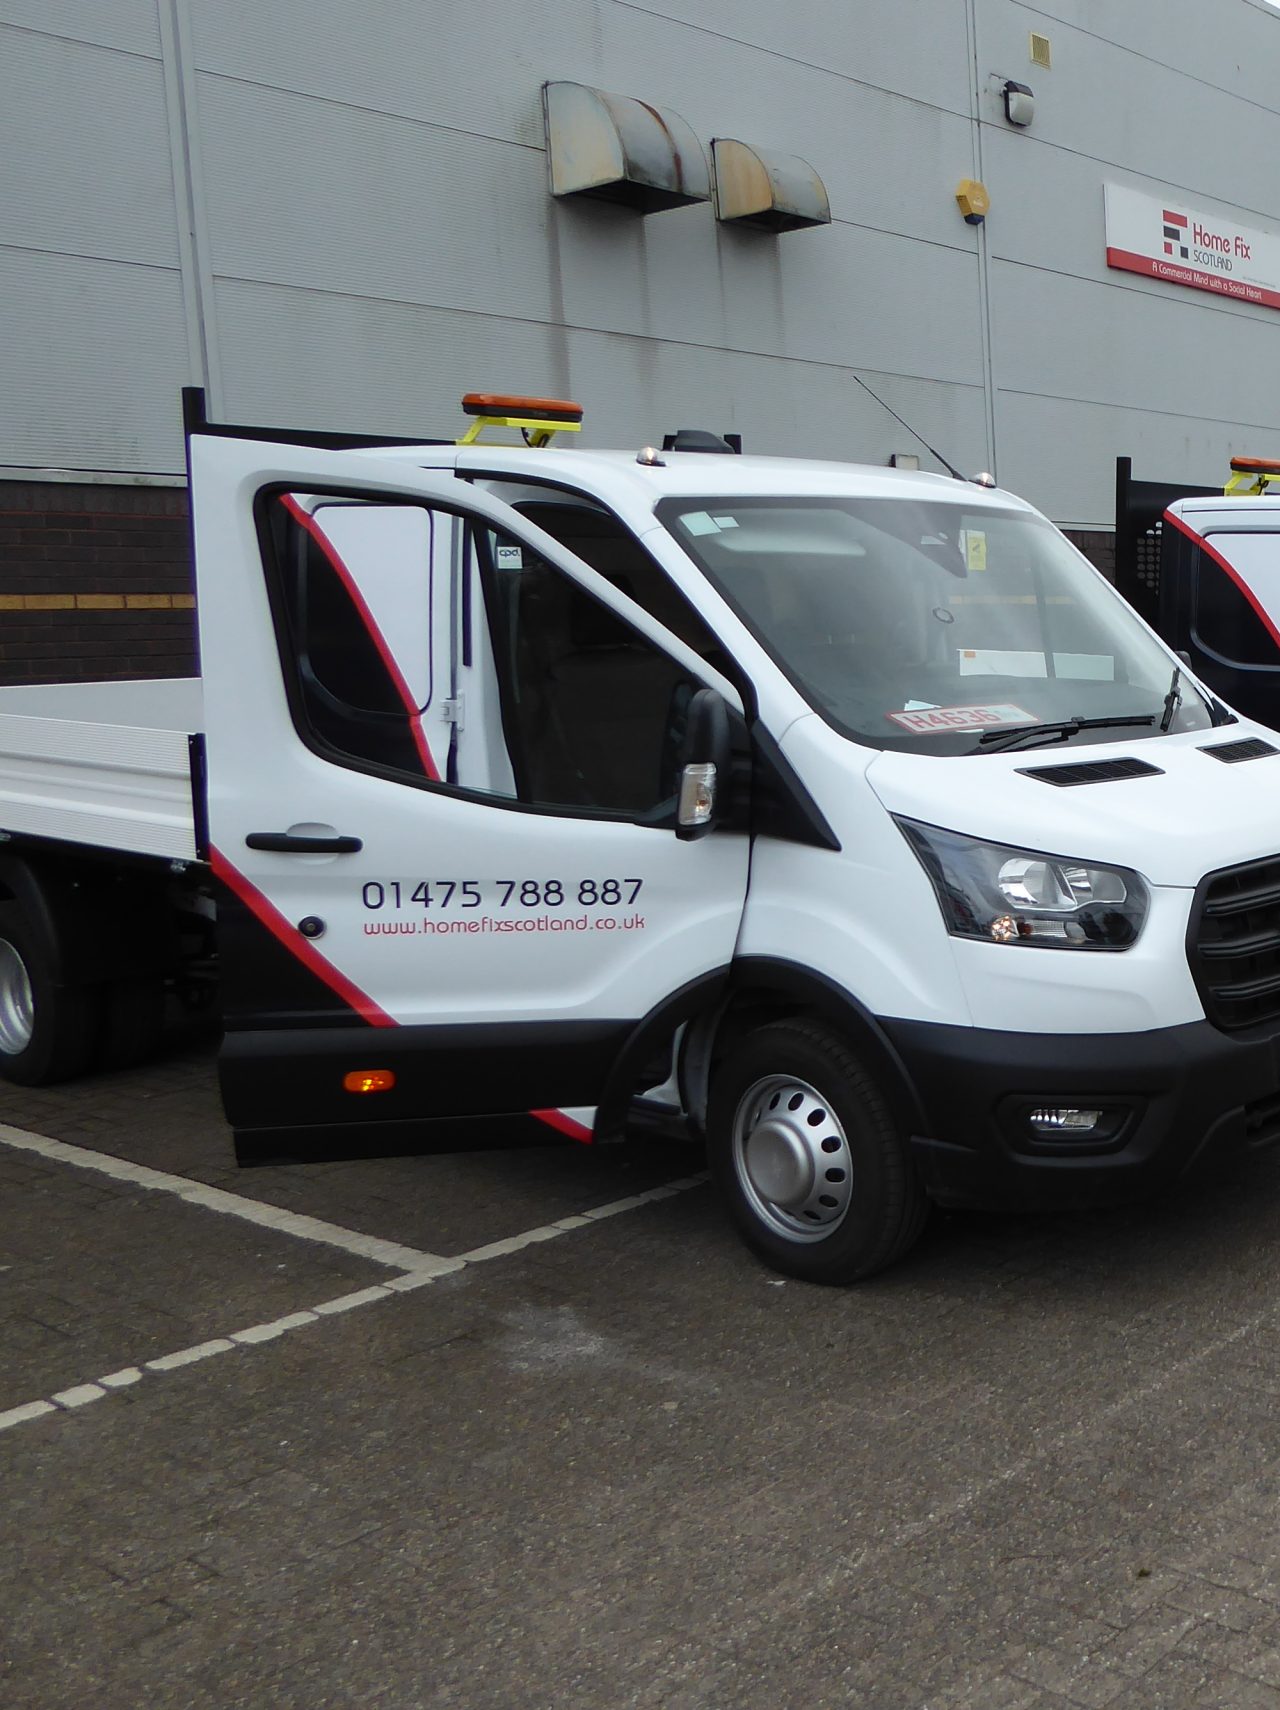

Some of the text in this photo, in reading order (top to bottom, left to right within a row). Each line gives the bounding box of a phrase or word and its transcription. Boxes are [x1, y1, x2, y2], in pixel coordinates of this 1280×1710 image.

[1193, 223, 1251, 260] Home Fix
[1193, 250, 1233, 271] SCOTLAND
[1152, 261, 1158, 272] A
[1160, 263, 1192, 281] Commercial
[1194, 272, 1209, 285] Mind
[1210, 278, 1222, 289] with
[1229, 282, 1245, 295] Social
[1247, 286, 1262, 299] Heart
[362, 878, 644, 910] 01475 788 887
[363, 913, 646, 936] www.homefixscotland.co.uk
